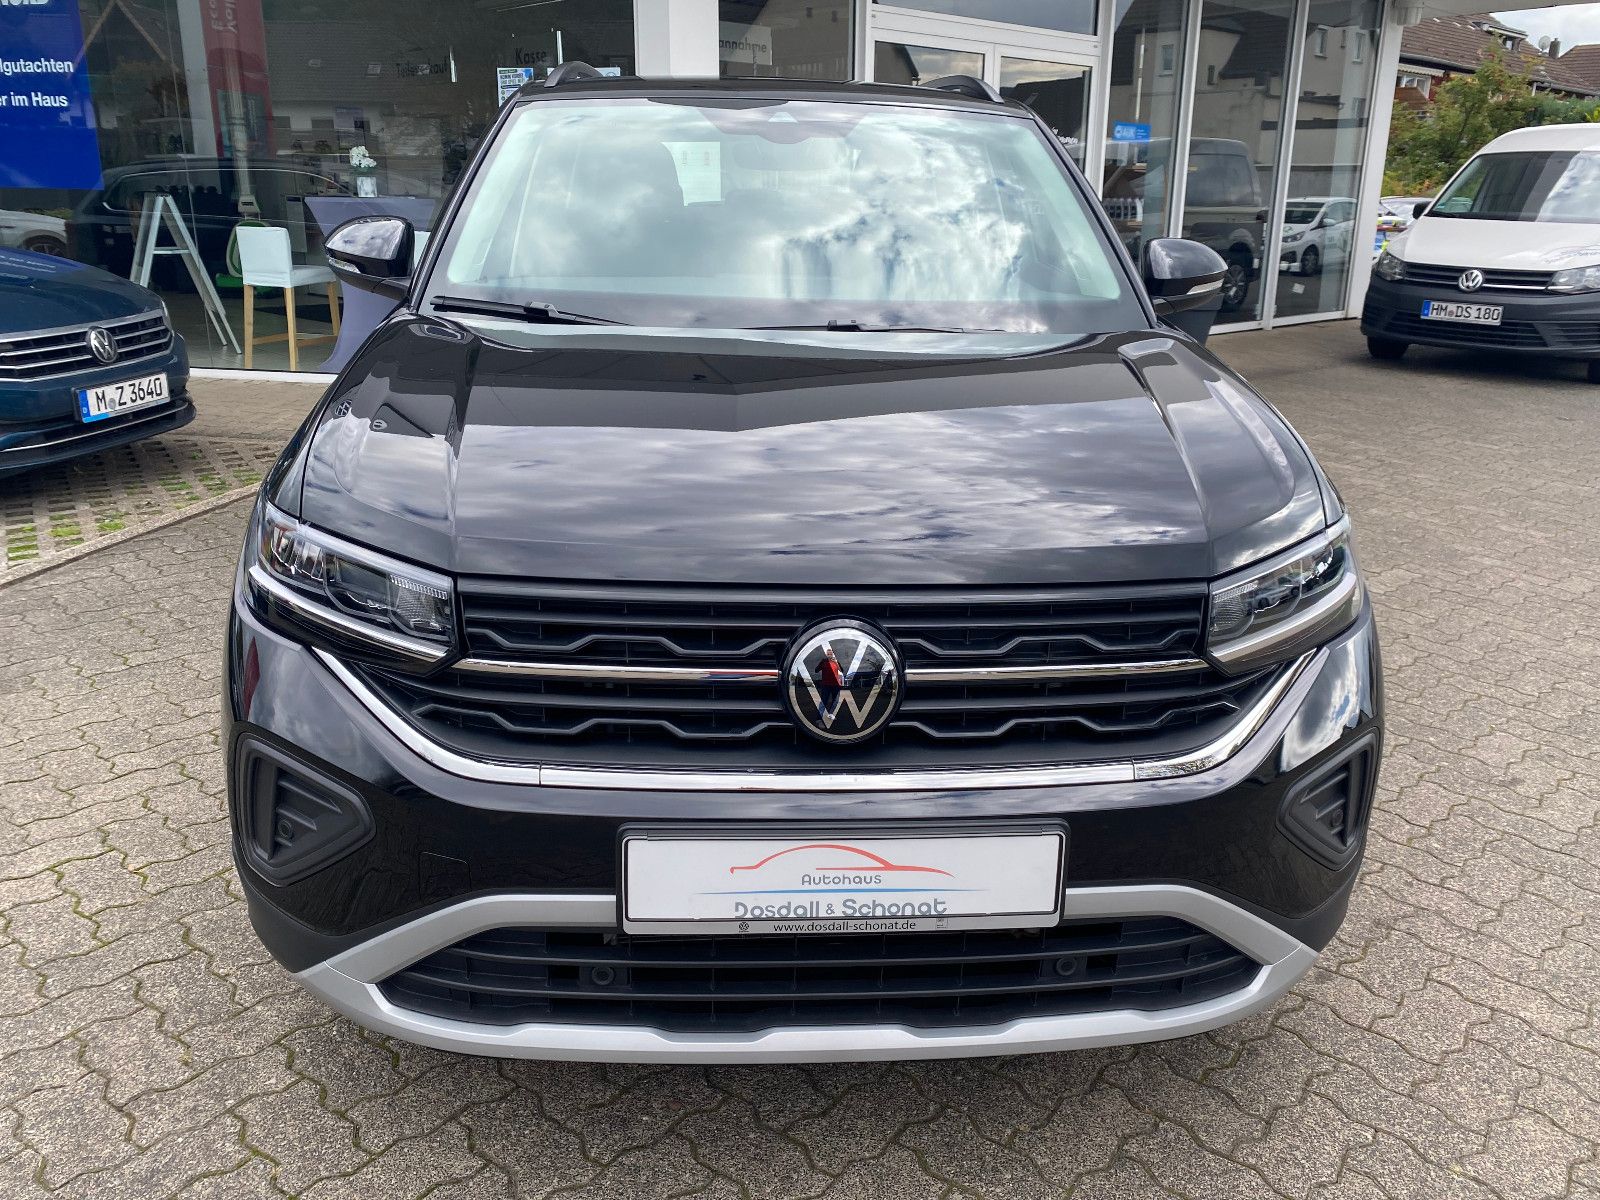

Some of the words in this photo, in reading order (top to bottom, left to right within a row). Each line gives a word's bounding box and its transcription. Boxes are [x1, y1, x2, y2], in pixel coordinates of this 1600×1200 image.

[515, 48, 546, 65] Kasse
[10, 91, 29, 107] im
[30, 91, 69, 107] Haus
[1430, 303, 1448, 317] HM
[1454, 305, 1472, 319] DS
[1474, 307, 1500, 321] 180
[95, 389, 108, 412] M
[115, 385, 127, 407] Z
[128, 377, 163, 403] 3640
[801, 873, 882, 886] Autohaus
[734, 901, 820, 918] Dosdall
[825, 903, 836, 916] &
[841, 898, 948, 917] Schonat
[773, 920, 917, 932] www.dosdall-schonat.de
